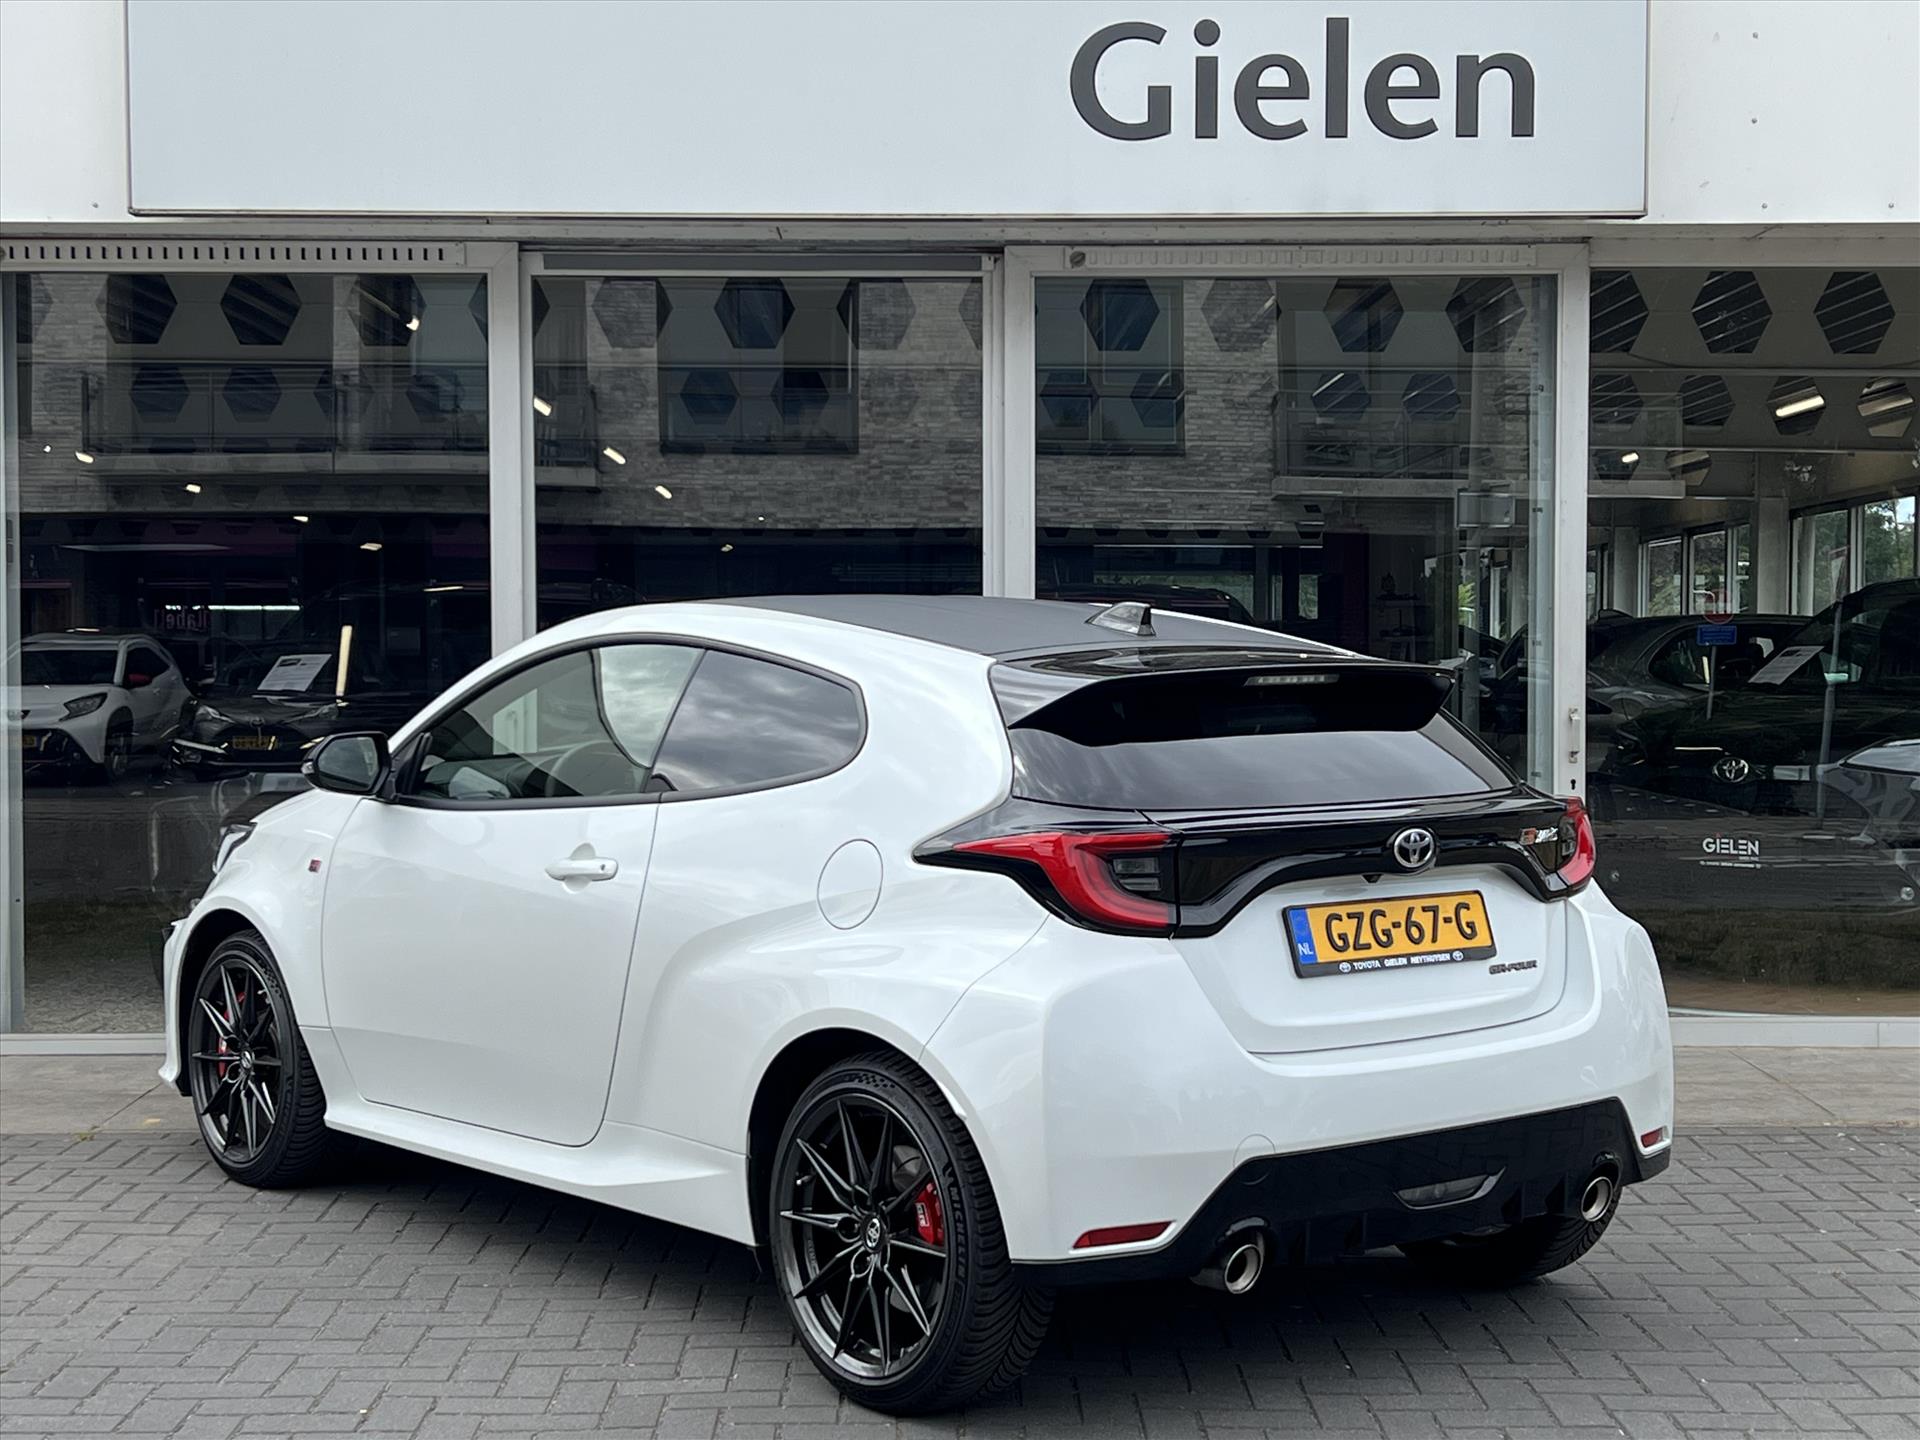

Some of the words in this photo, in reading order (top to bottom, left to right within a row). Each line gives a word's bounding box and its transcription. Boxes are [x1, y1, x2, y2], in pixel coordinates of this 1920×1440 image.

[1069, 17, 1536, 141] Gielen
[1702, 837, 1760, 856] GIELEN
[1324, 902, 1478, 953] GZG-67-G
[1298, 942, 1314, 956] NL
[1353, 959, 1381, 971] TOYOTA
[1384, 957, 1408, 967] GIELEN
[949, 1186, 967, 1279] MICHELIN
